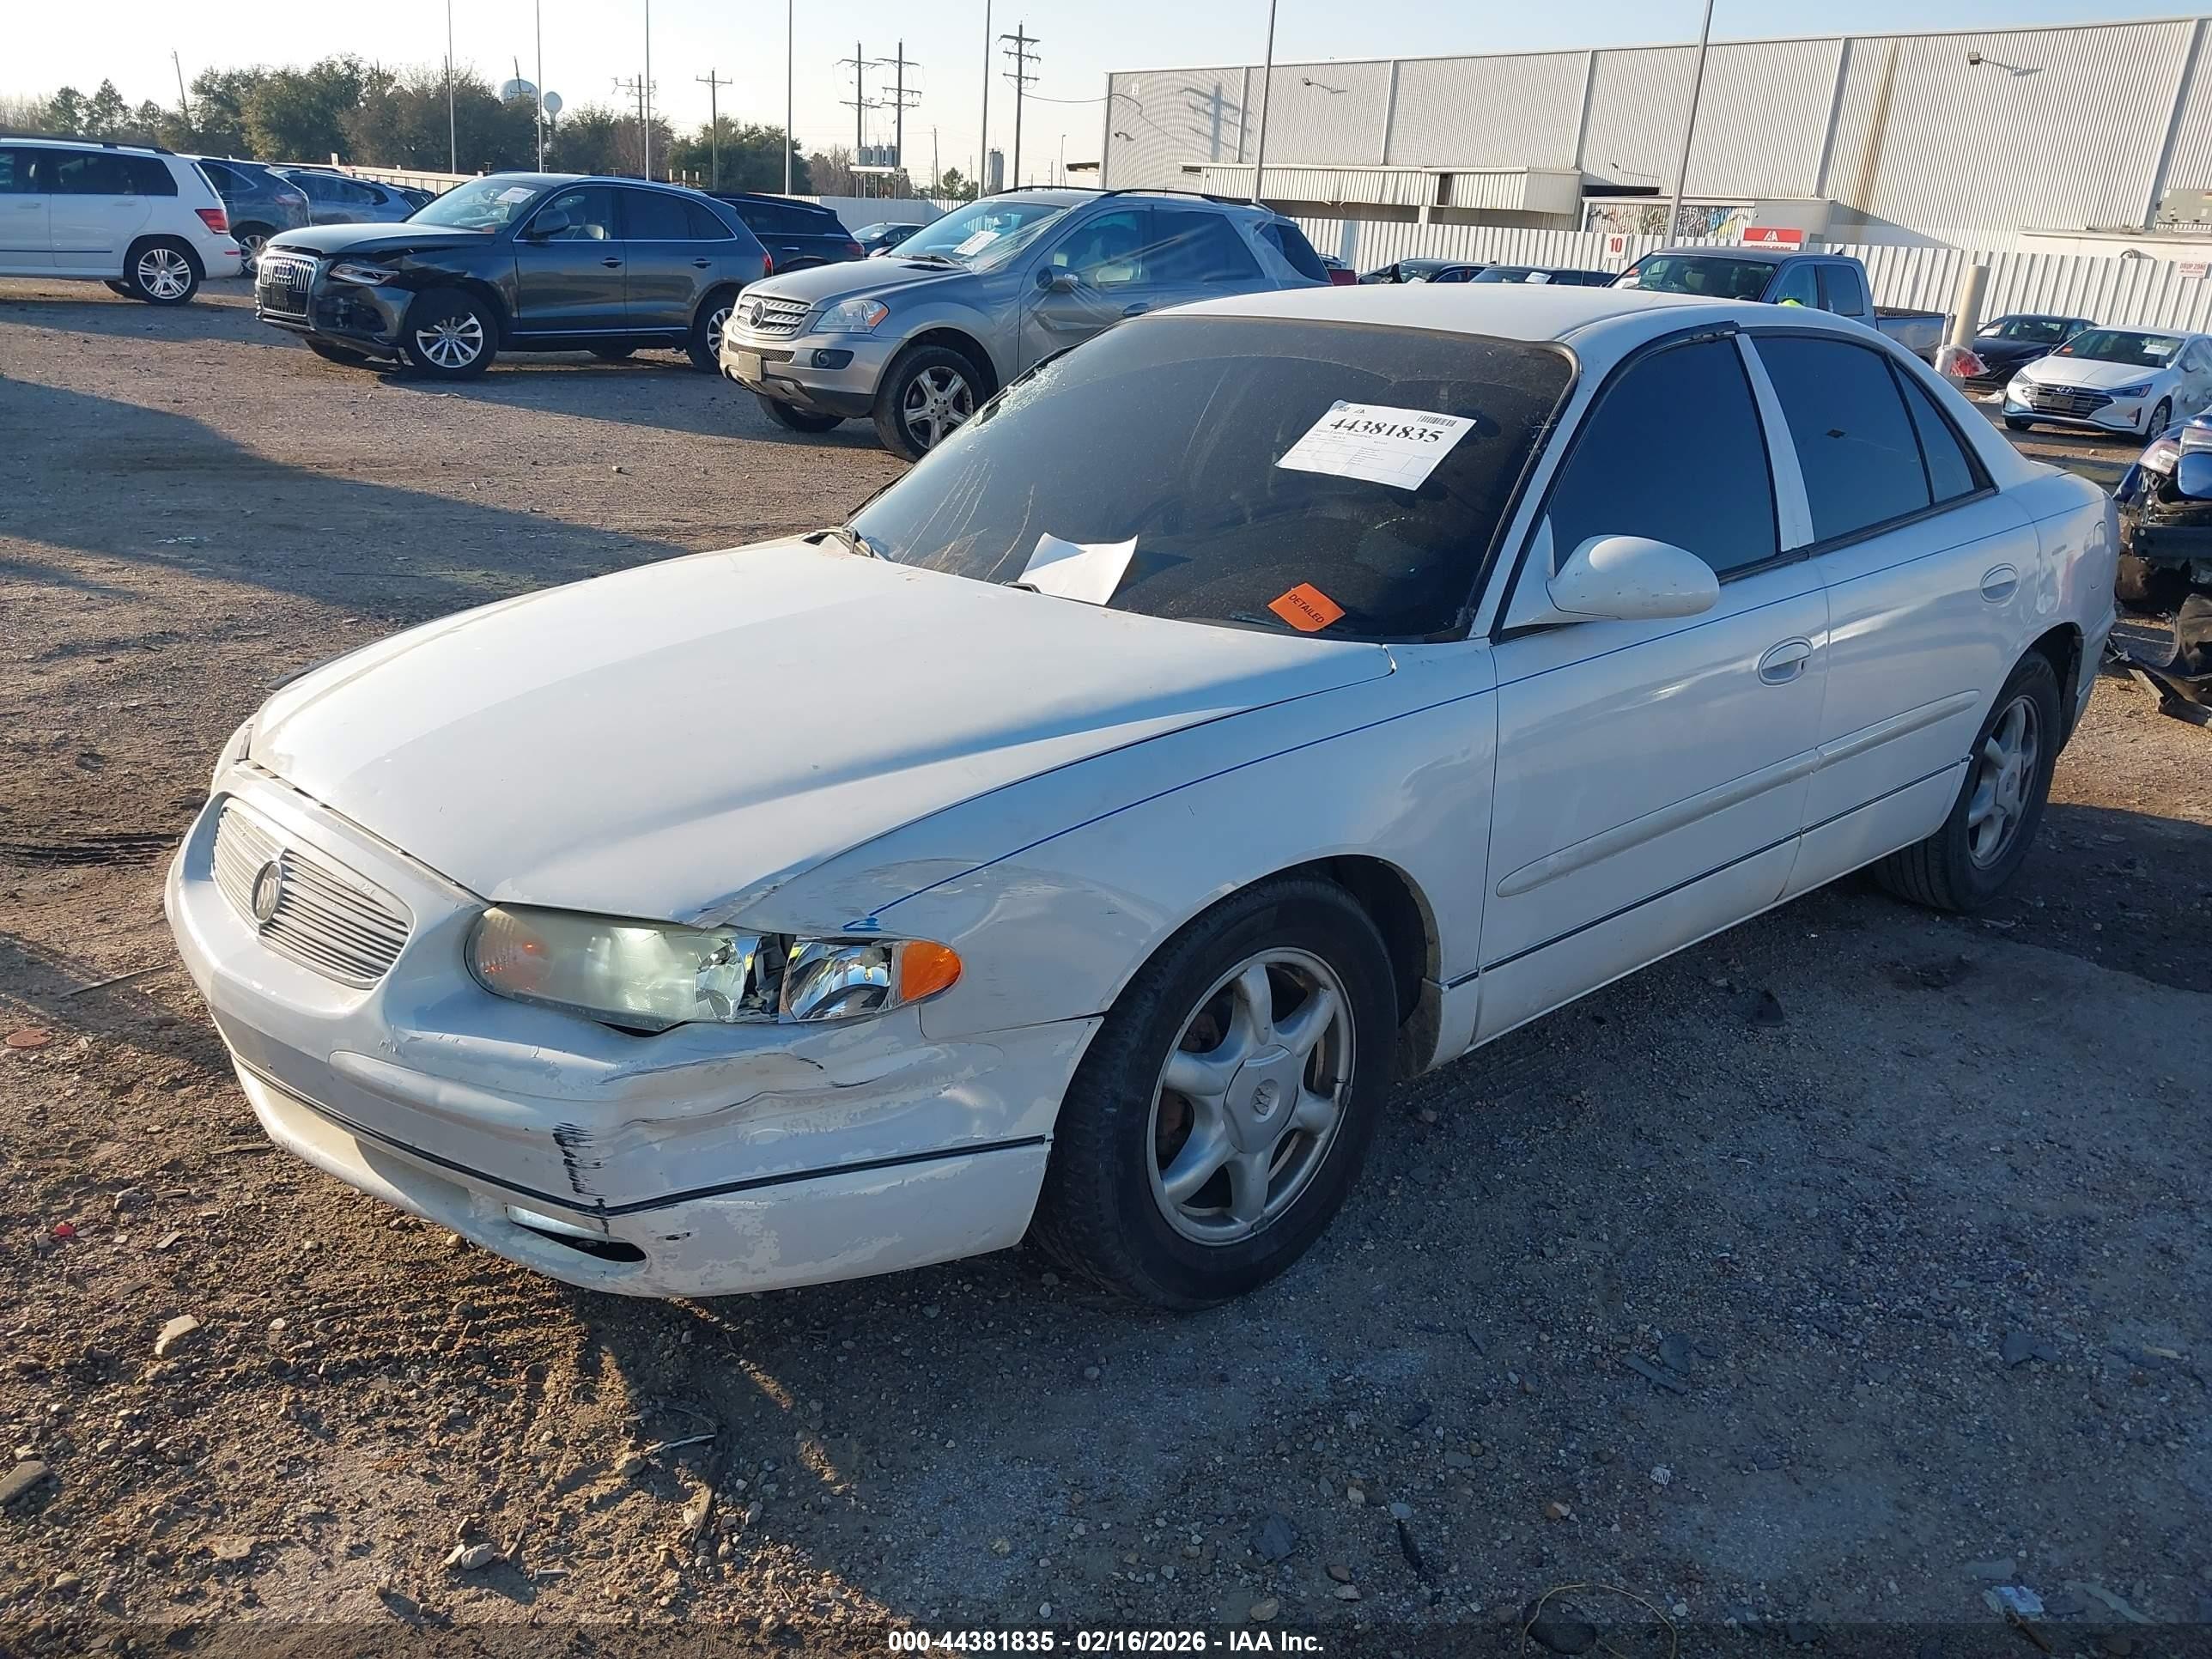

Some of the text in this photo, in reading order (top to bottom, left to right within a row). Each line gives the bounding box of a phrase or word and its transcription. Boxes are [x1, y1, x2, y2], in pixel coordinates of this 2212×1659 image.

[1610, 237, 1623, 252] 10
[1329, 418, 1445, 443] 44381835
[1288, 594, 1324, 623] DETAILED
